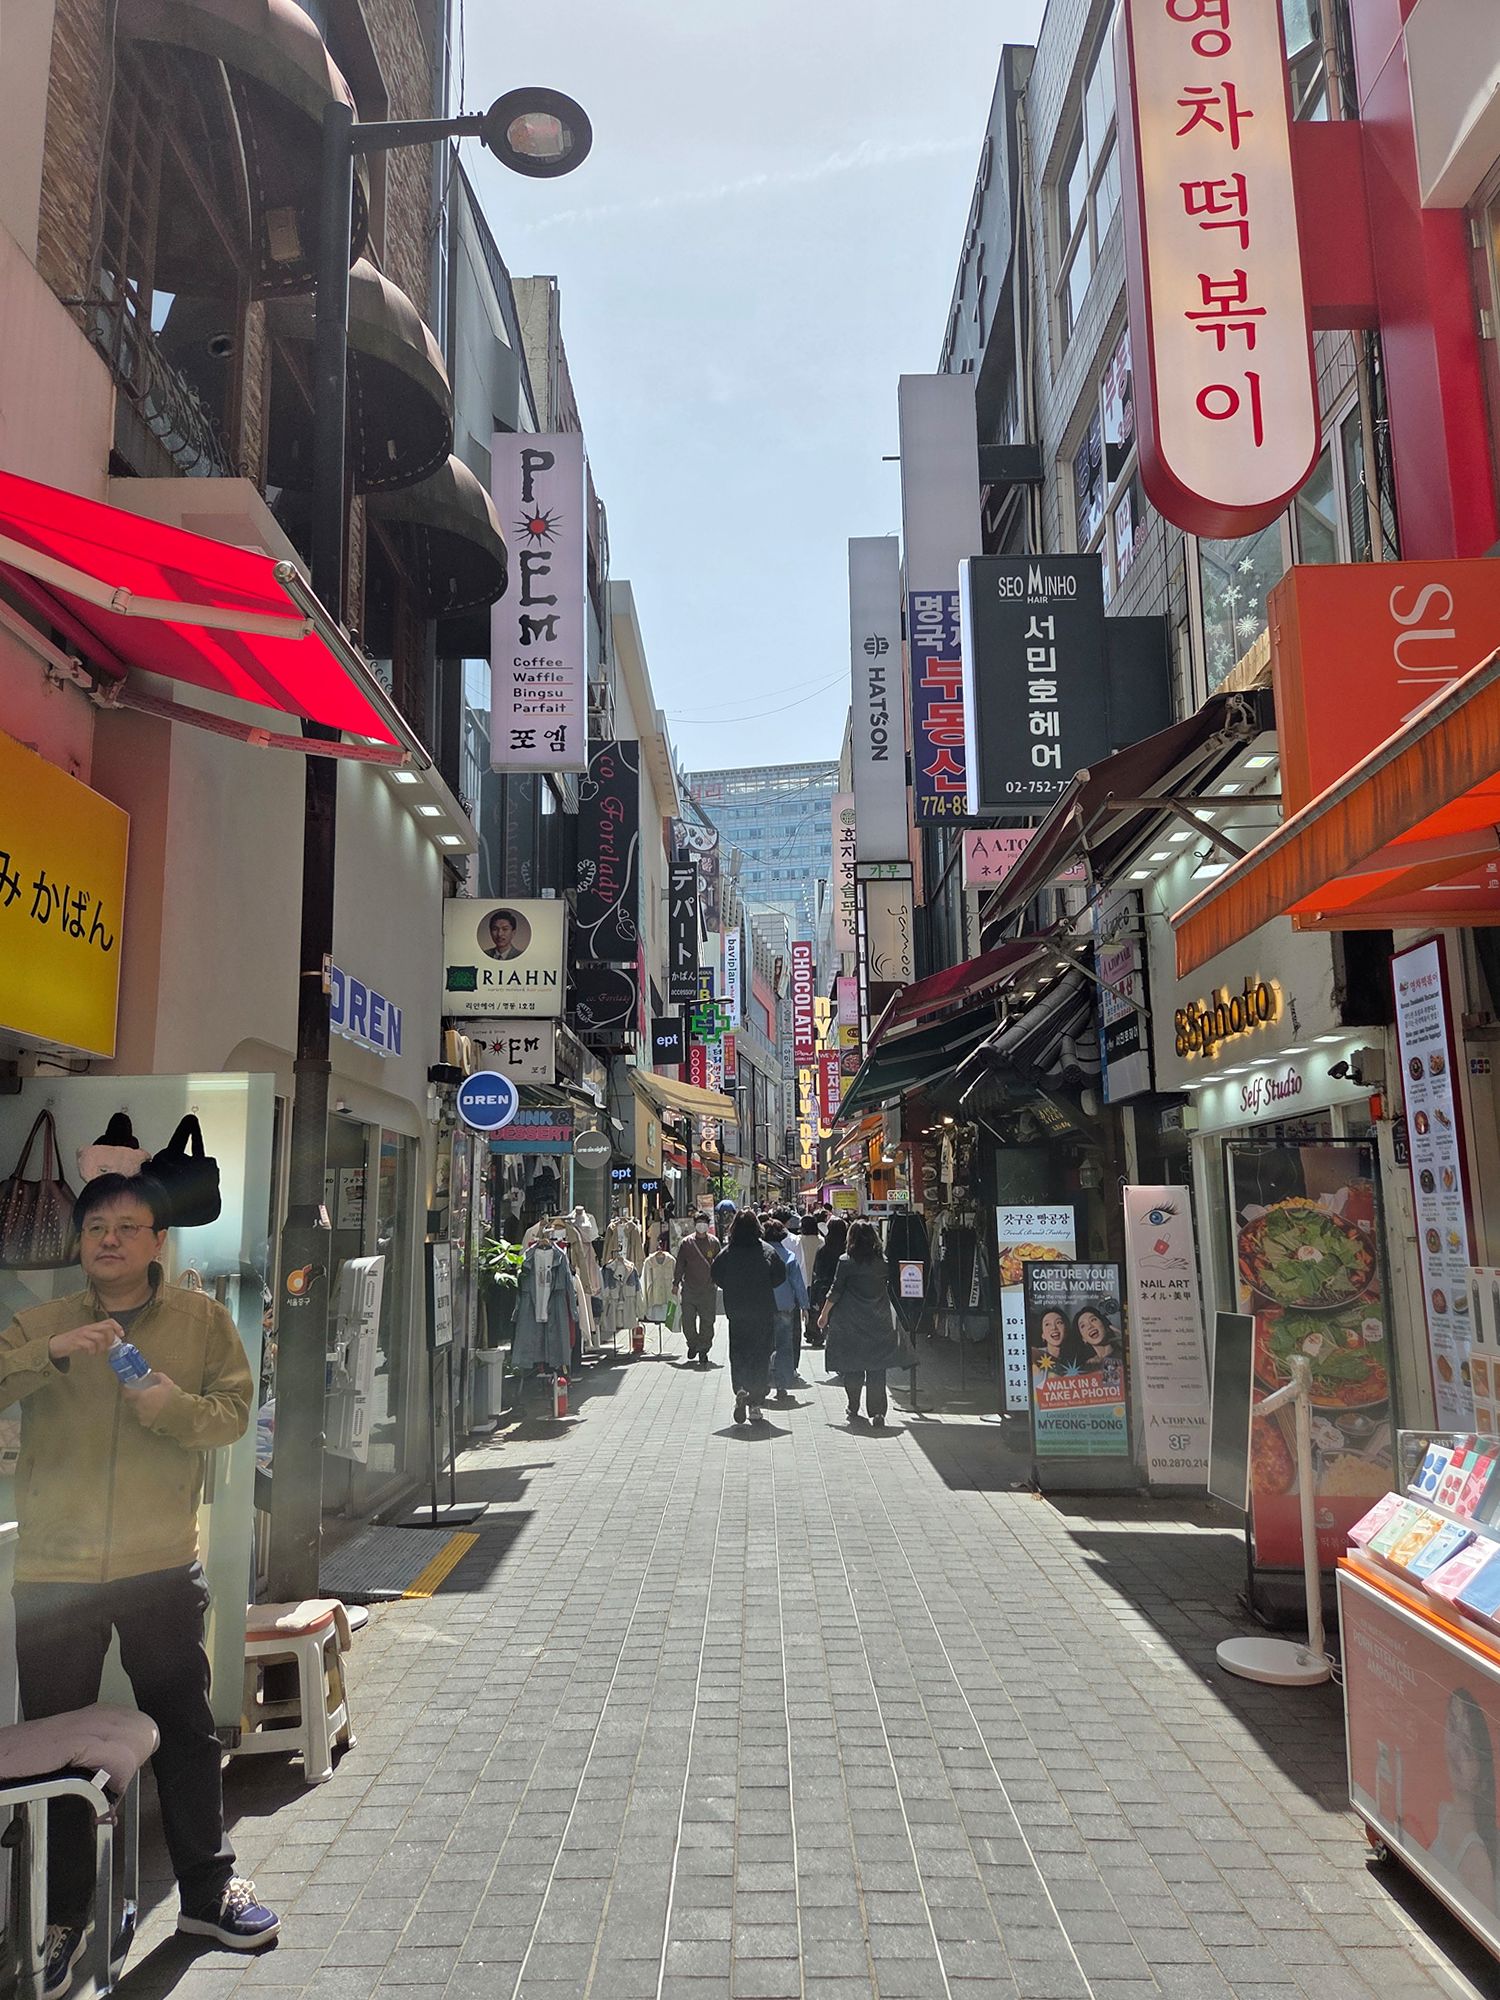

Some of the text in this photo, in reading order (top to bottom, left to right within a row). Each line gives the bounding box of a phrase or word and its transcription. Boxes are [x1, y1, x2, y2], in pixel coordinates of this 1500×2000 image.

[1166, 0, 1267, 448] 영차떡볶이
[998, 563, 1077, 597] SEO MINHO
[1026, 596, 1049, 605] HAIR
[512, 656, 564, 668] Coffee
[512, 671, 565, 683] Waffle
[512, 686, 564, 699] Bingsu
[1023, 615, 1063, 769] 서민호헤어
[512, 702, 567, 713] Parfait
[868, 666, 889, 762] HATSON
[591, 796, 625, 904] Forelady
[869, 864, 901, 878] 가무
[30, 870, 114, 952] かばん
[670, 867, 696, 966] デパート
[482, 969, 558, 986] RIAHN
[671, 970, 697, 982] かばん
[670, 988, 696, 997] accessory
[793, 946, 812, 1046] CHOCOLATE
[1174, 976, 1277, 1058] 88photo
[656, 1033, 679, 1047] ept
[1239, 1066, 1303, 1116] Self Studio
[557, 1110, 571, 1125] &
[489, 1125, 573, 1142] DESSERT
[611, 1167, 632, 1180] ept
[641, 1181, 658, 1191] ept
[1003, 1213, 1071, 1226] 갓구운 빵공장
[1032, 1268, 1115, 1280] CAPTURE YOUR
[1033, 1280, 1115, 1292] KOREA MOMENT
[1140, 1279, 1190, 1289] NAIL ART
[1046, 1377, 1099, 1391] WALK IN &
[1043, 1386, 1121, 1402] TAKE A PHOTO!
[1038, 1419, 1123, 1430] MYEONG-DONG
[1168, 1433, 1192, 1451] 3F
